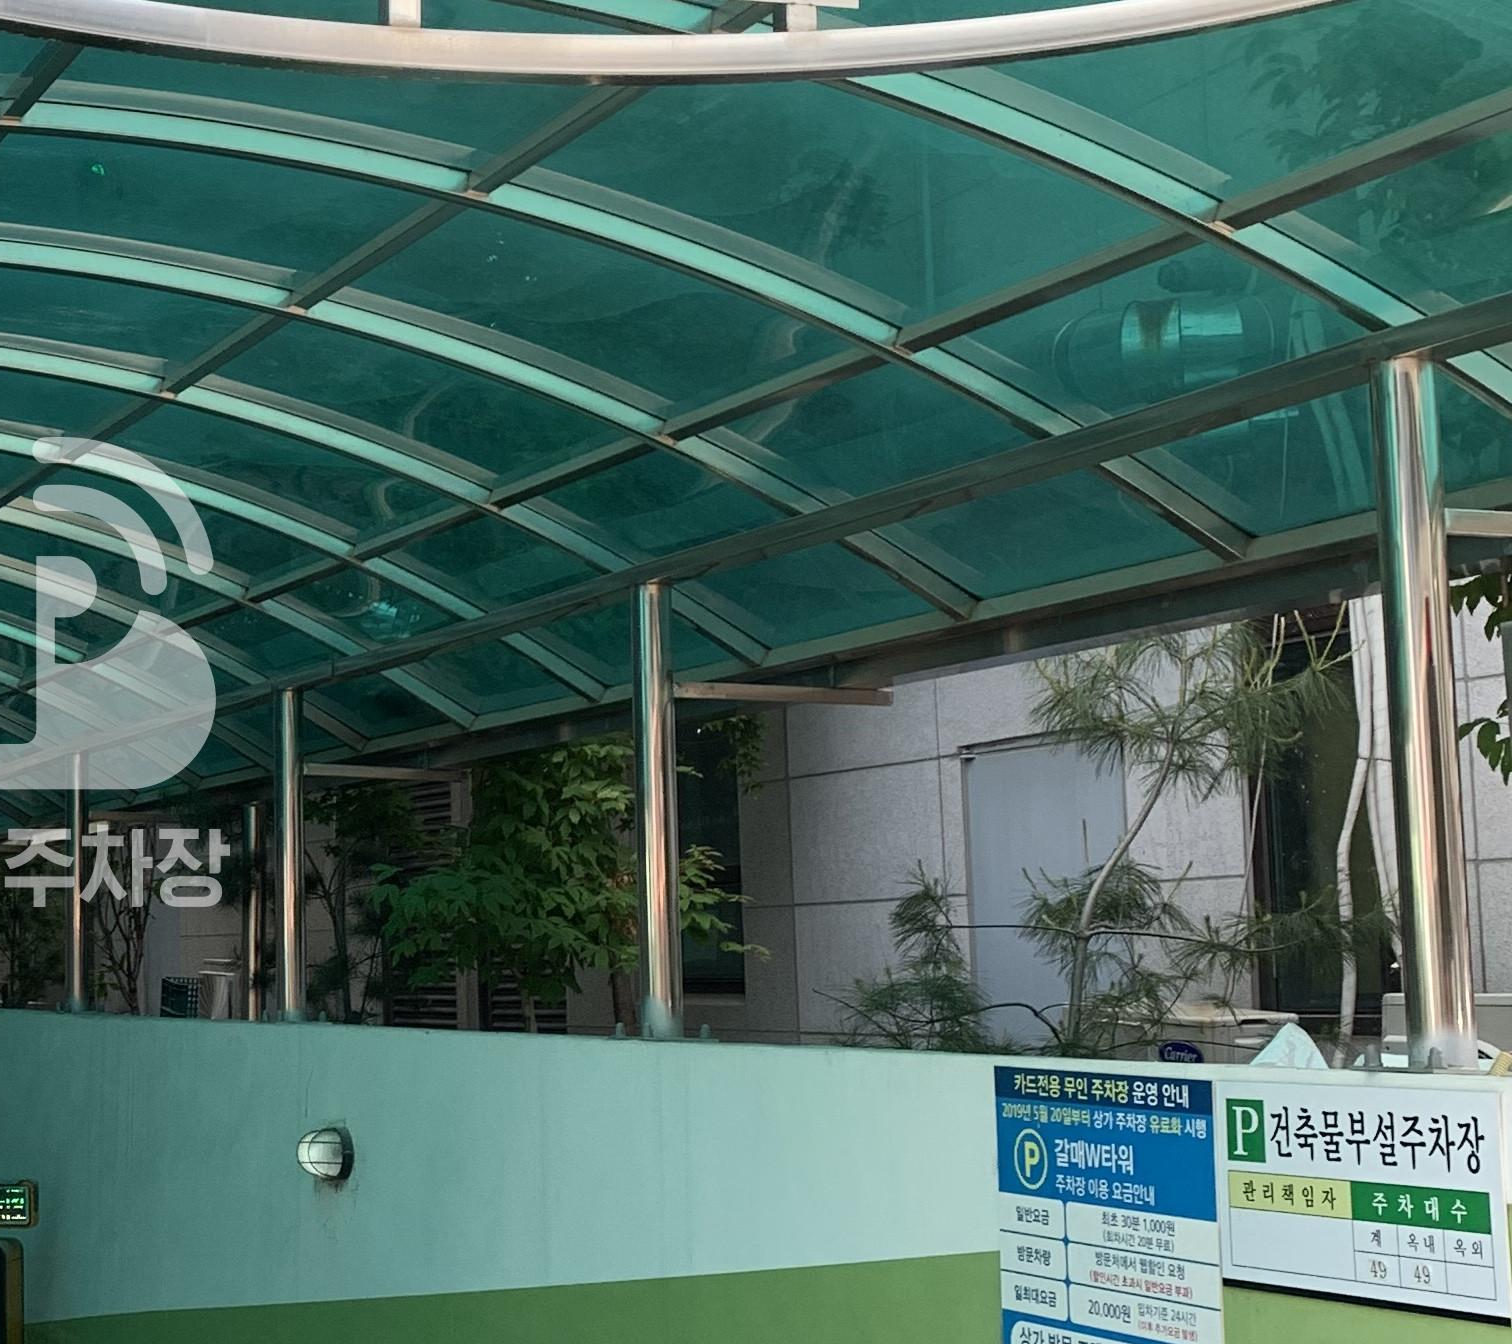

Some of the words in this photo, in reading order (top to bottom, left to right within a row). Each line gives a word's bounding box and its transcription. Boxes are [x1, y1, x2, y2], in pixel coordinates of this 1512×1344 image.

[1014, 1074, 1061, 1098] 카드전용
[1064, 1077, 1088, 1100] 무인
[1091, 1078, 1129, 1104] 주차장
[1132, 1081, 1158, 1107] 운영
[1162, 1084, 1189, 1108] 안내
[1001, 1102, 1032, 1122] 2019년
[1033, 1105, 1048, 1123] 5월
[1050, 1107, 1091, 1128] 20일부터
[1093, 1110, 1114, 1130] 상가
[1116, 1112, 1147, 1134] 주차장
[1149, 1115, 1183, 1136] 유료화
[1184, 1118, 1207, 1139] 시행
[1231, 1105, 1259, 1156] P
[1269, 1105, 1485, 1175] 건축물부설주차장
[1023, 1140, 1040, 1178] P
[1054, 1138, 1135, 1176] 갈매W타워
[1055, 1173, 1086, 1197] 주차장
[1088, 1177, 1109, 1200] 이용
[1112, 1182, 1156, 1206] 요금안내
[1241, 1179, 1337, 1211] 관리책임자
[1015, 1206, 1050, 1226] 일반요금
[1371, 1192, 1468, 1225] 주차대수
[1102, 1211, 1119, 1227] 최초
[1121, 1214, 1140, 1232] 30분
[1142, 1218, 1176, 1237] 1,000원
[1016, 1245, 1051, 1267] 방문차량
[1407, 1233, 1435, 1254] 옥내
[1453, 1238, 1484, 1259] 옥외
[1095, 1251, 1137, 1272] 방문처에서
[1370, 1259, 1388, 1280] 49
[1413, 1264, 1431, 1285] 49
[1014, 1284, 1057, 1308] 일최대요금
[1088, 1299, 1132, 1325] 20,000원
[1170, 1308, 1197, 1327] 24시간
